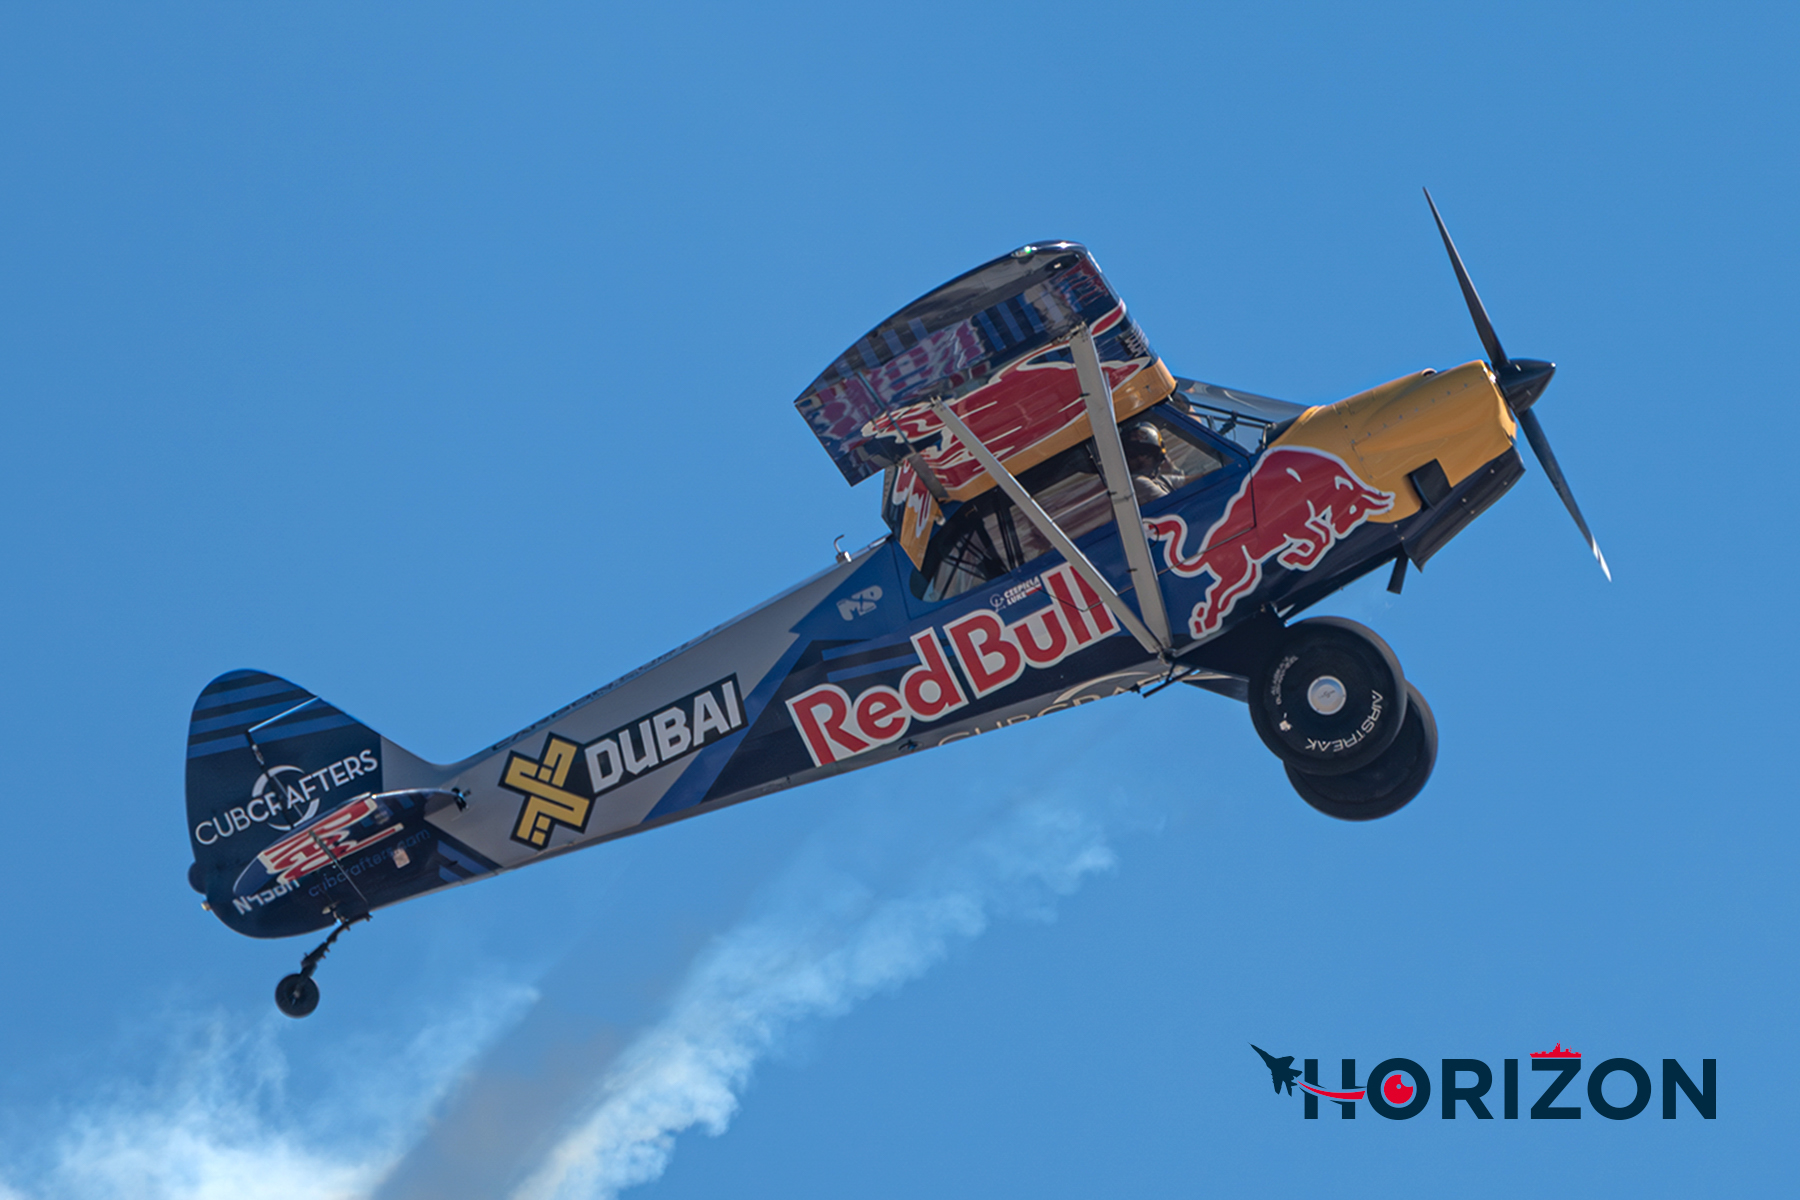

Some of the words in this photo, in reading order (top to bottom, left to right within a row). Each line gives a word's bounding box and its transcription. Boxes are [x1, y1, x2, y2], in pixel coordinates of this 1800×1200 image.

[786, 627, 969, 767] Red
[941, 561, 1121, 698] Bull
[584, 679, 743, 794] DUBAI
[1305, 689, 1384, 753] AIRSTREAK
[194, 749, 379, 846] CUBCRAFTERS
[307, 828, 432, 898] cubcrafterscom
